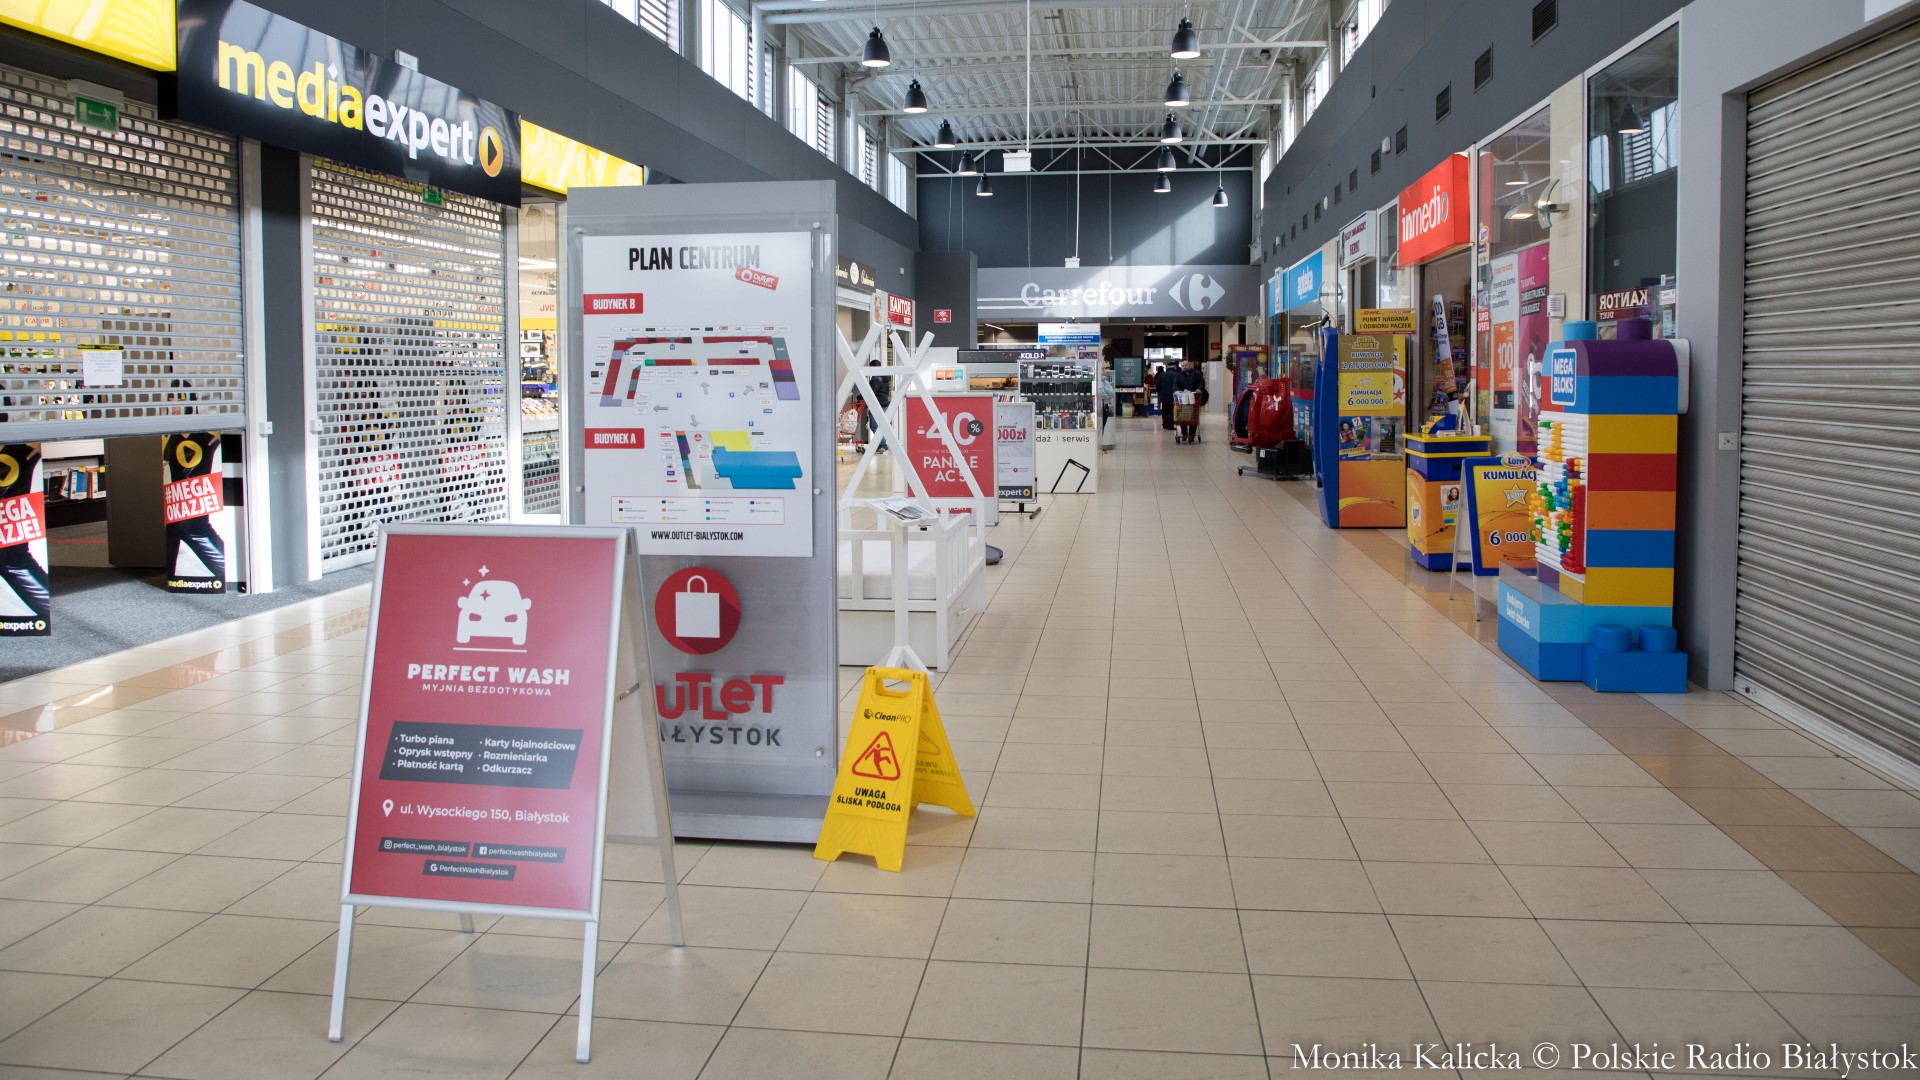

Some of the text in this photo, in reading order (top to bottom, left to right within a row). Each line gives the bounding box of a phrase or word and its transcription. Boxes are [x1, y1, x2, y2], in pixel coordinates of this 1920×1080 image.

[218, 40, 474, 165] mediaexpert
[1401, 185, 1449, 243] inmedio
[629, 245, 760, 271] PLAN CENTRUM
[1020, 280, 1157, 307] Carrefour
[539, 304, 555, 312] JVC
[592, 298, 636, 310] BUDYNEK B
[889, 295, 911, 316] KANTOR
[1351, 351, 1384, 359] KUMULACJA
[1497, 342, 1513, 370] 100
[1553, 358, 1574, 375] MEGA
[1553, 376, 1574, 394] BLOKS
[1347, 398, 1354, 406] 6
[594, 433, 636, 444] BUDYNEK A
[1061, 435, 1090, 443] serwis
[934, 470, 956, 482] AC
[1483, 470, 1537, 482] KUMULACJ
[165, 476, 216, 504] #MEGA
[998, 488, 1022, 497] expert
[166, 494, 220, 521] OKAZJE!
[651, 531, 743, 541] WWW.OUTLET-BIALYSTOK.COM
[1490, 530, 1501, 546] 6
[168, 580, 213, 589] mediaexpert
[407, 663, 570, 686] PERFECT WASH
[422, 683, 552, 697] MYJNIA BEZDOTYKOWA
[399, 734, 455, 747] Turbo piana
[484, 738, 577, 752] Karty lojalnościowe
[398, 746, 474, 761] Oprysk wstępny
[483, 751, 548, 763] Rozmieniarka
[397, 759, 464, 774] Płatność kartą
[482, 763, 533, 775] Odkurzacz
[855, 787, 886, 800] UWAGA
[836, 793, 901, 812] ŚLISKA PODŁOGA
[400, 804, 570, 825] ul. Wysockiego 150, Białystok
[488, 847, 558, 860] perfectwashbialystok
[439, 864, 509, 877] PerfectWashBialystok
